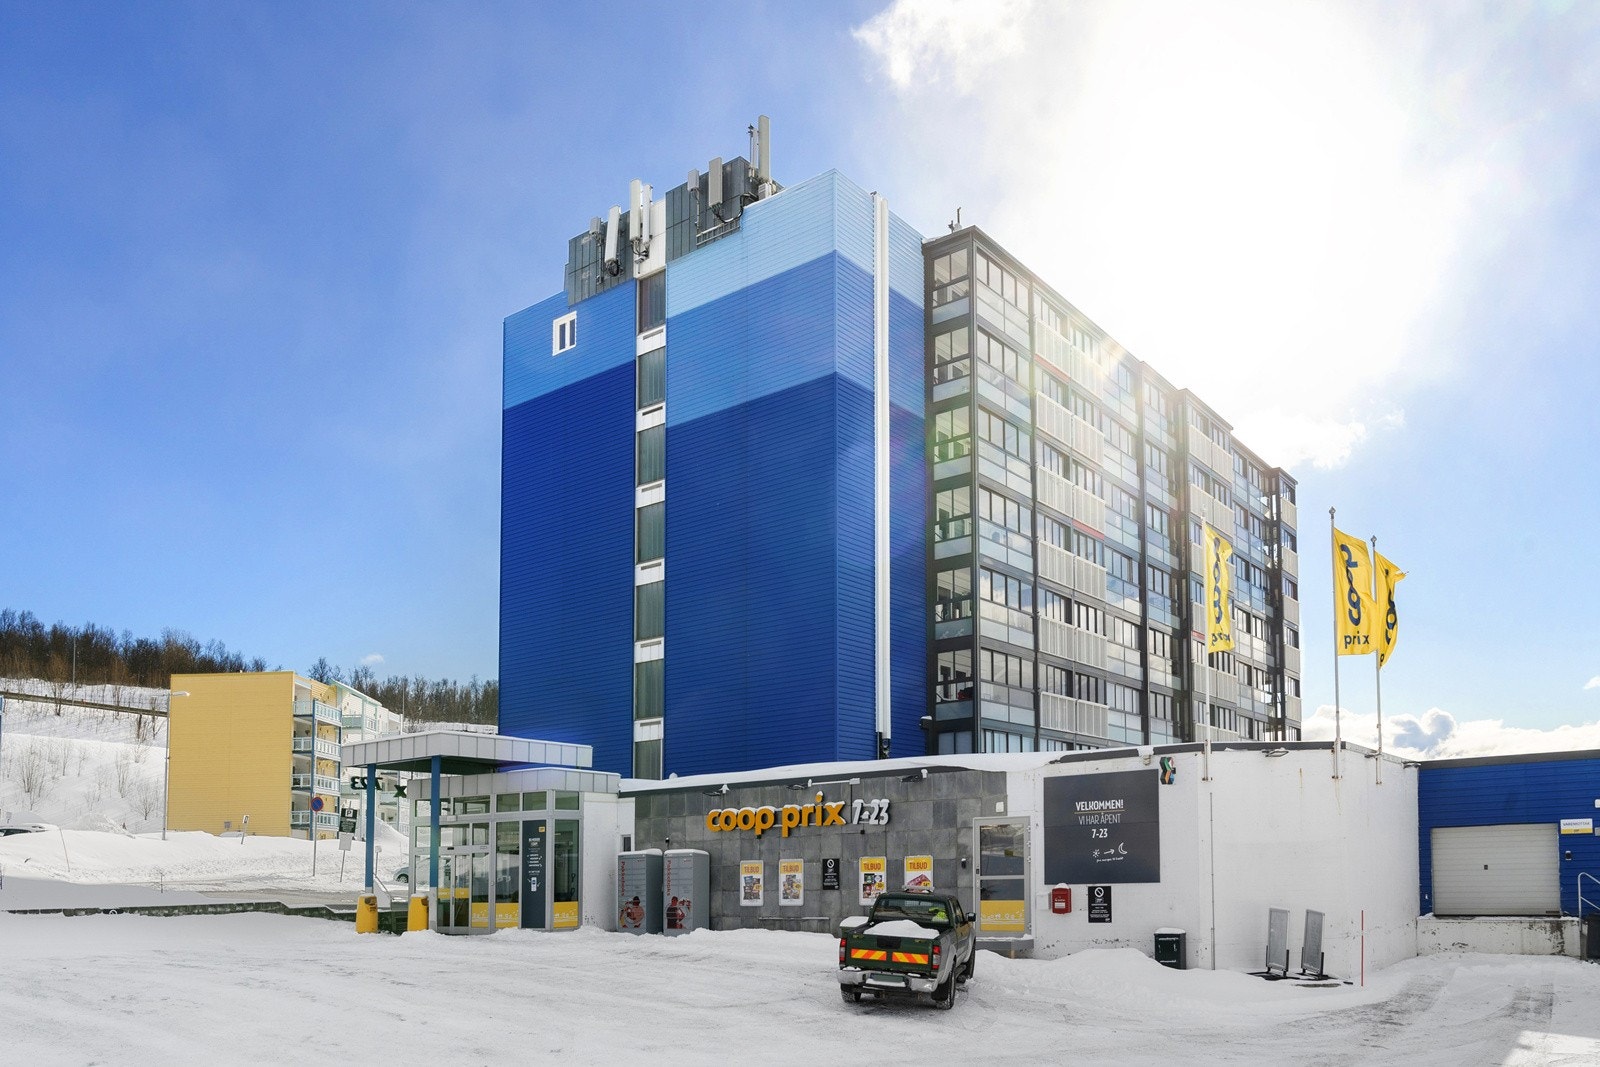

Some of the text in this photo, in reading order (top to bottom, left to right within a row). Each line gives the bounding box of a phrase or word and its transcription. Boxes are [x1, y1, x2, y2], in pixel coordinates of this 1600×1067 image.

[1344, 630, 1370, 650] prix
[1075, 799, 1124, 811] VELKOMMEN!
[706, 791, 891, 838] coop prix 7-23
[1078, 811, 1121, 825] VI HAR ÅPENT
[1091, 828, 1108, 839] 7-23
[863, 862, 882, 871] TILBUD
[909, 861, 928, 870] TILBUD
